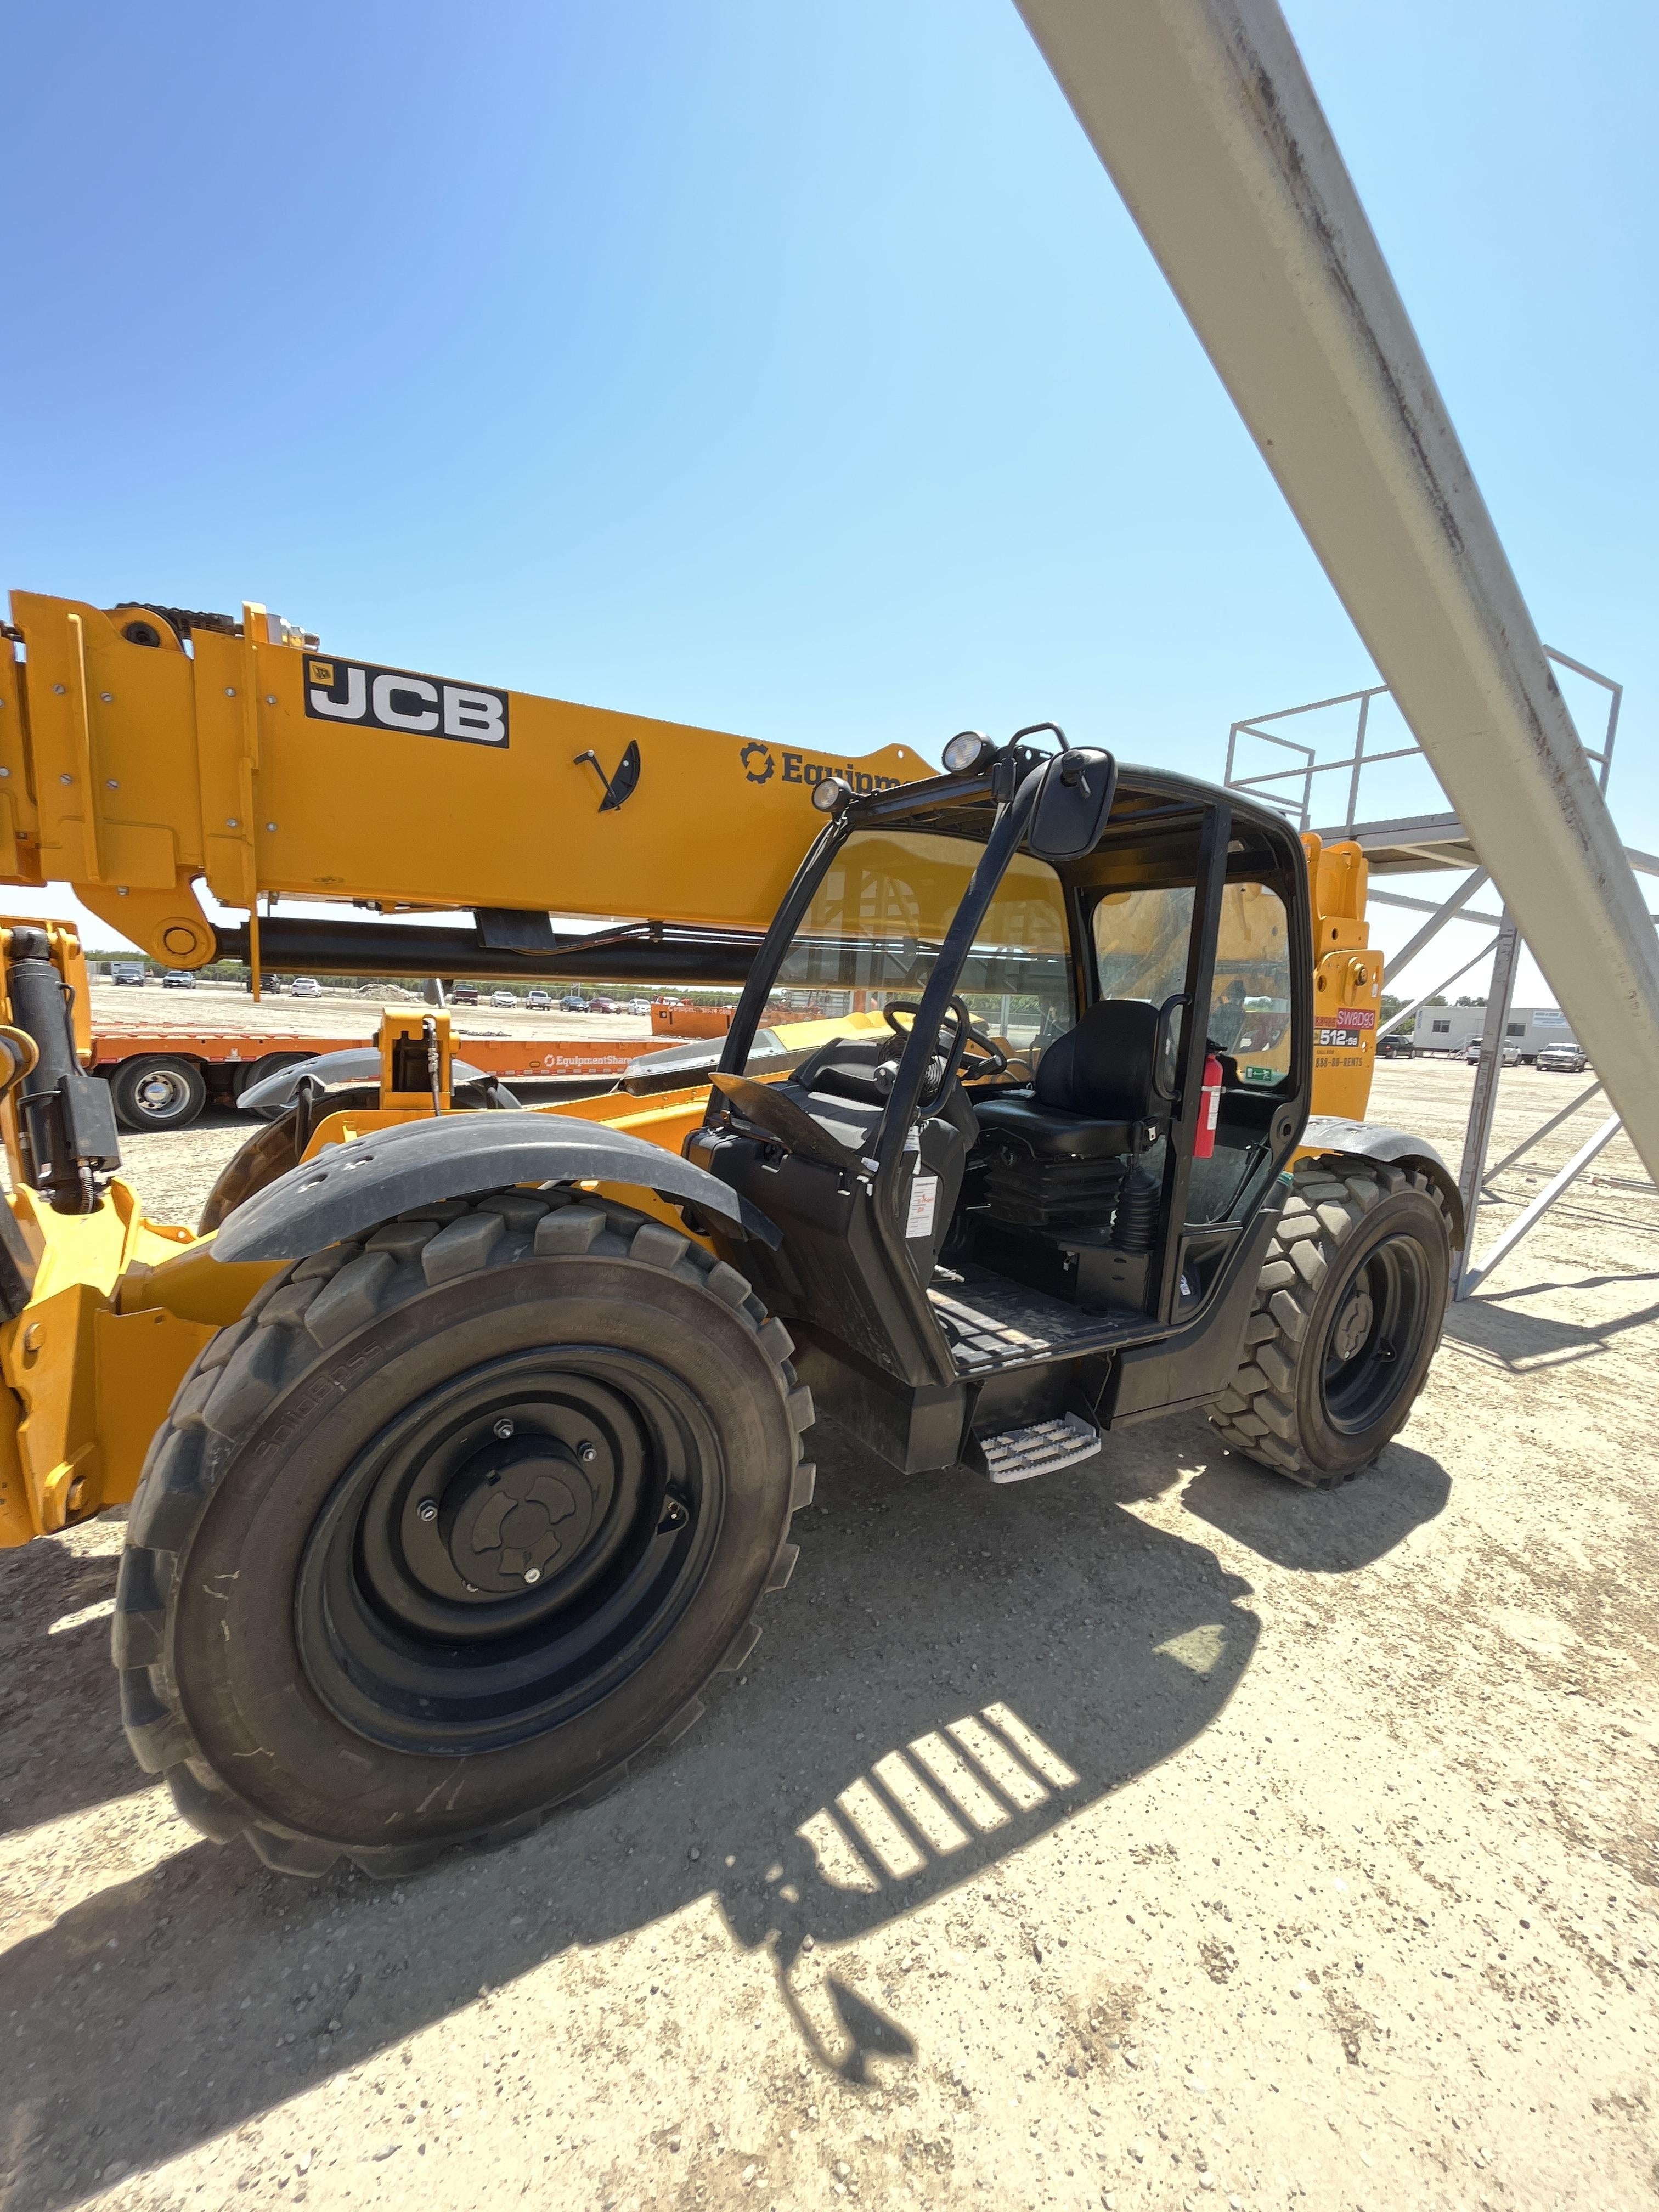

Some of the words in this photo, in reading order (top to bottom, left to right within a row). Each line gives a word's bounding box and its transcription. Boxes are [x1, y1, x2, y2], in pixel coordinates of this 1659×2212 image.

[309, 668, 505, 742] JCB
[782, 752, 913, 794] Equipm
[1338, 1010, 1374, 1026] SW8D93
